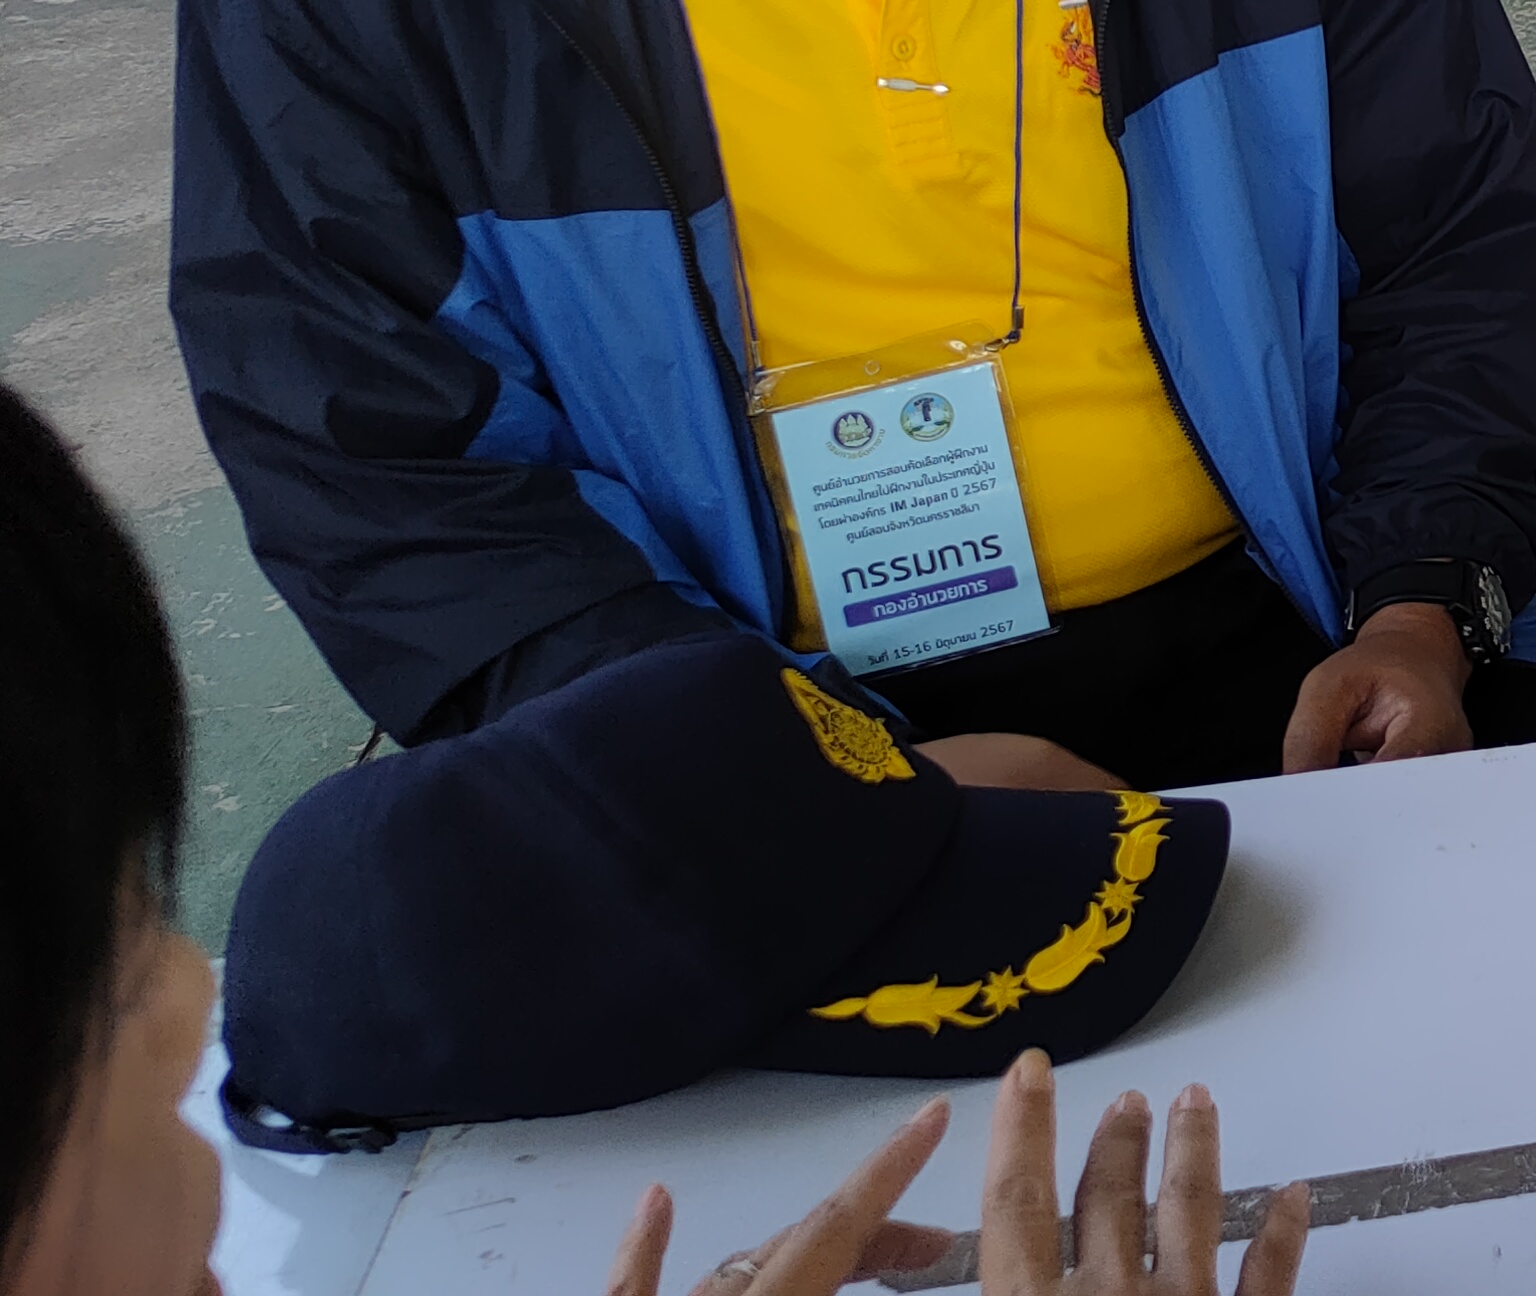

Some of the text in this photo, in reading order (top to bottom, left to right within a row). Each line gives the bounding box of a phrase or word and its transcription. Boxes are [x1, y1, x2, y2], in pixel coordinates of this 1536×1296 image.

[890, 500, 907, 513] IM
[911, 490, 948, 508] Japan
[951, 486, 959, 499] ปี
[963, 477, 997, 496] 2567
[846, 502, 981, 544] ศูนย์สอบจังหวัดนครราชสีมา
[841, 534, 1003, 593] กรรมการ
[873, 579, 988, 618] กองอำนวยการ
[868, 620, 1014, 666] วันที่ 15-16 มิถุนายน 2567
